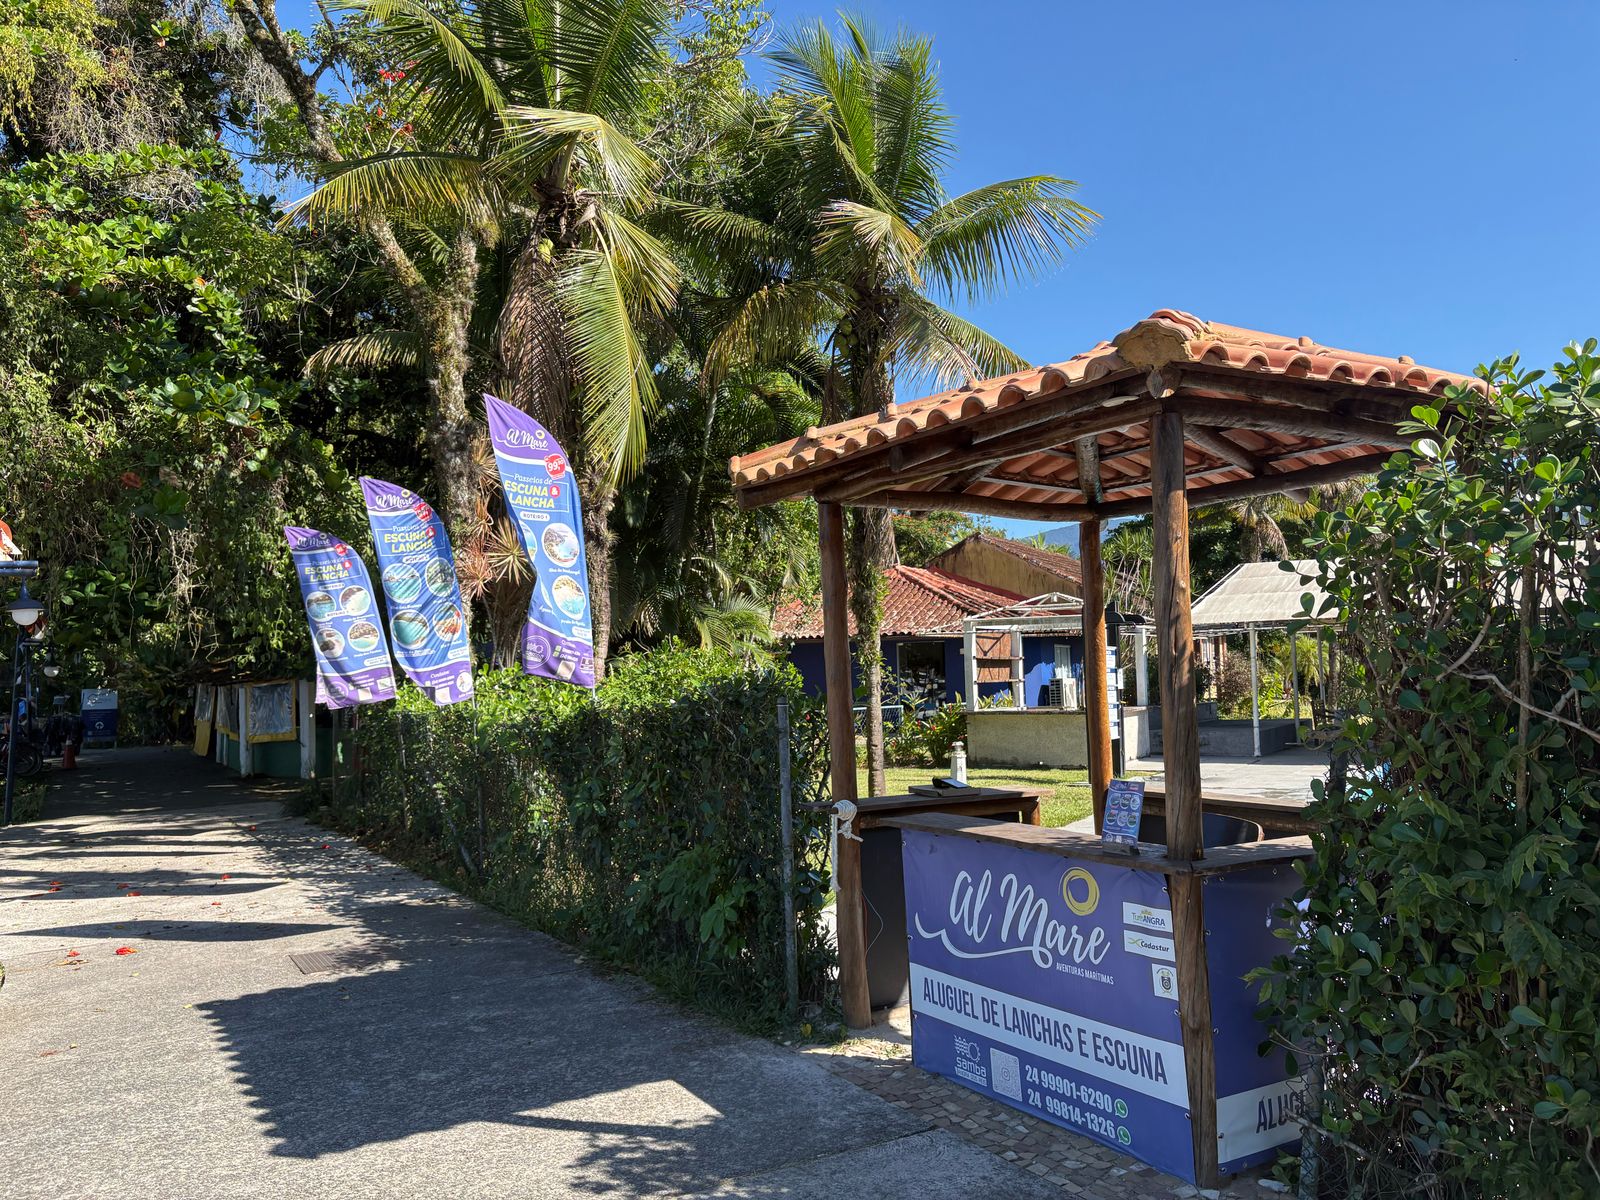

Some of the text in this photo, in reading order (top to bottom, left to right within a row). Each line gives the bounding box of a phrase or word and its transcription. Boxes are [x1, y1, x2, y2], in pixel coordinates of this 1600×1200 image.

[520, 430, 549, 449] Mare
[513, 473, 543, 485] Passeios
[504, 480, 548, 496] ESCUNA
[387, 494, 413, 508] Mare
[508, 493, 555, 508] LANCHA
[384, 530, 426, 543] ESCUNA
[391, 540, 433, 553] LANCHA
[304, 563, 343, 575] ESCUNA
[310, 570, 350, 582] LANCHA
[1000, 873, 1111, 968] Mare
[1140, 940, 1170, 953] Cadastur
[1056, 962, 1114, 985] AVENTURAS MARÍTIMAS
[923, 977, 1169, 1086] ALUGUEL DE LANCHAS E ESCUNA
[956, 1056, 987, 1078] samba
[1025, 1064, 1113, 1114] 24 99901-6290
[1027, 1088, 1116, 1139] 24 99814-1326
